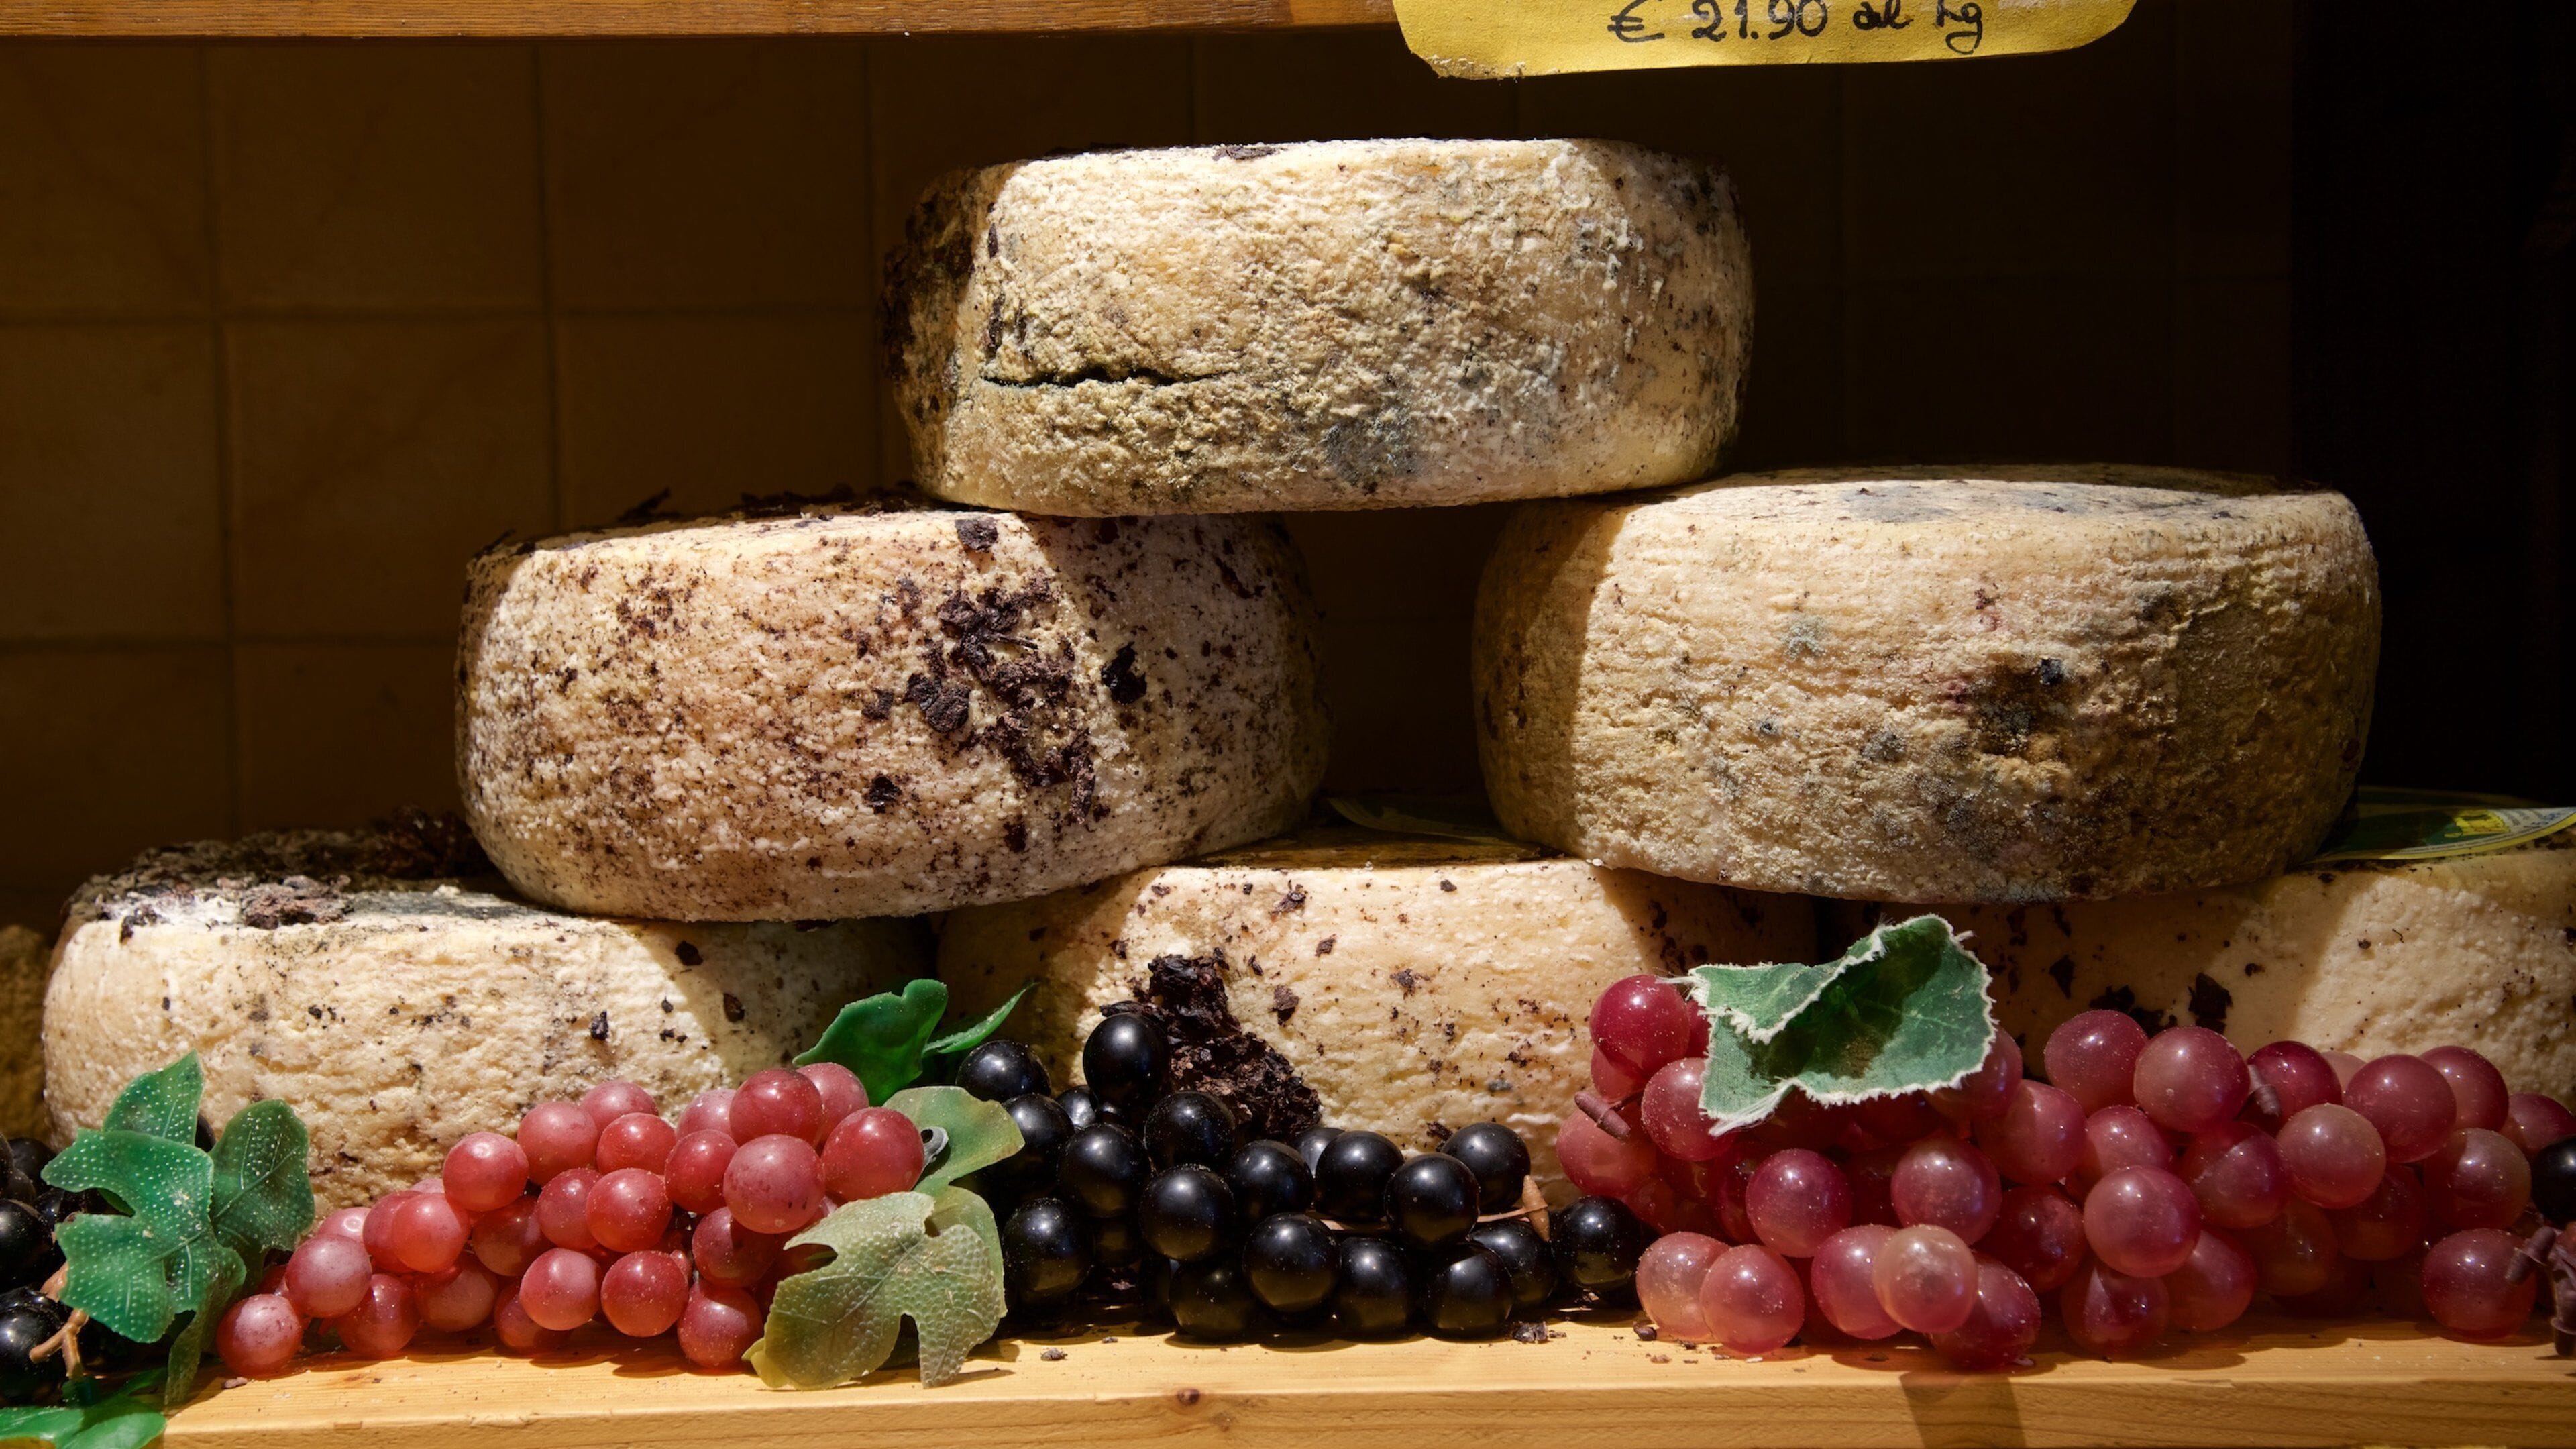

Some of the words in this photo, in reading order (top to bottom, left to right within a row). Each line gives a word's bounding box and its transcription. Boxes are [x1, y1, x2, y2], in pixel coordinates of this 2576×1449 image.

[1607, 0, 1665, 42] €
[1691, 0, 1829, 42] 21.90
[1852, 0, 1915, 31] al
